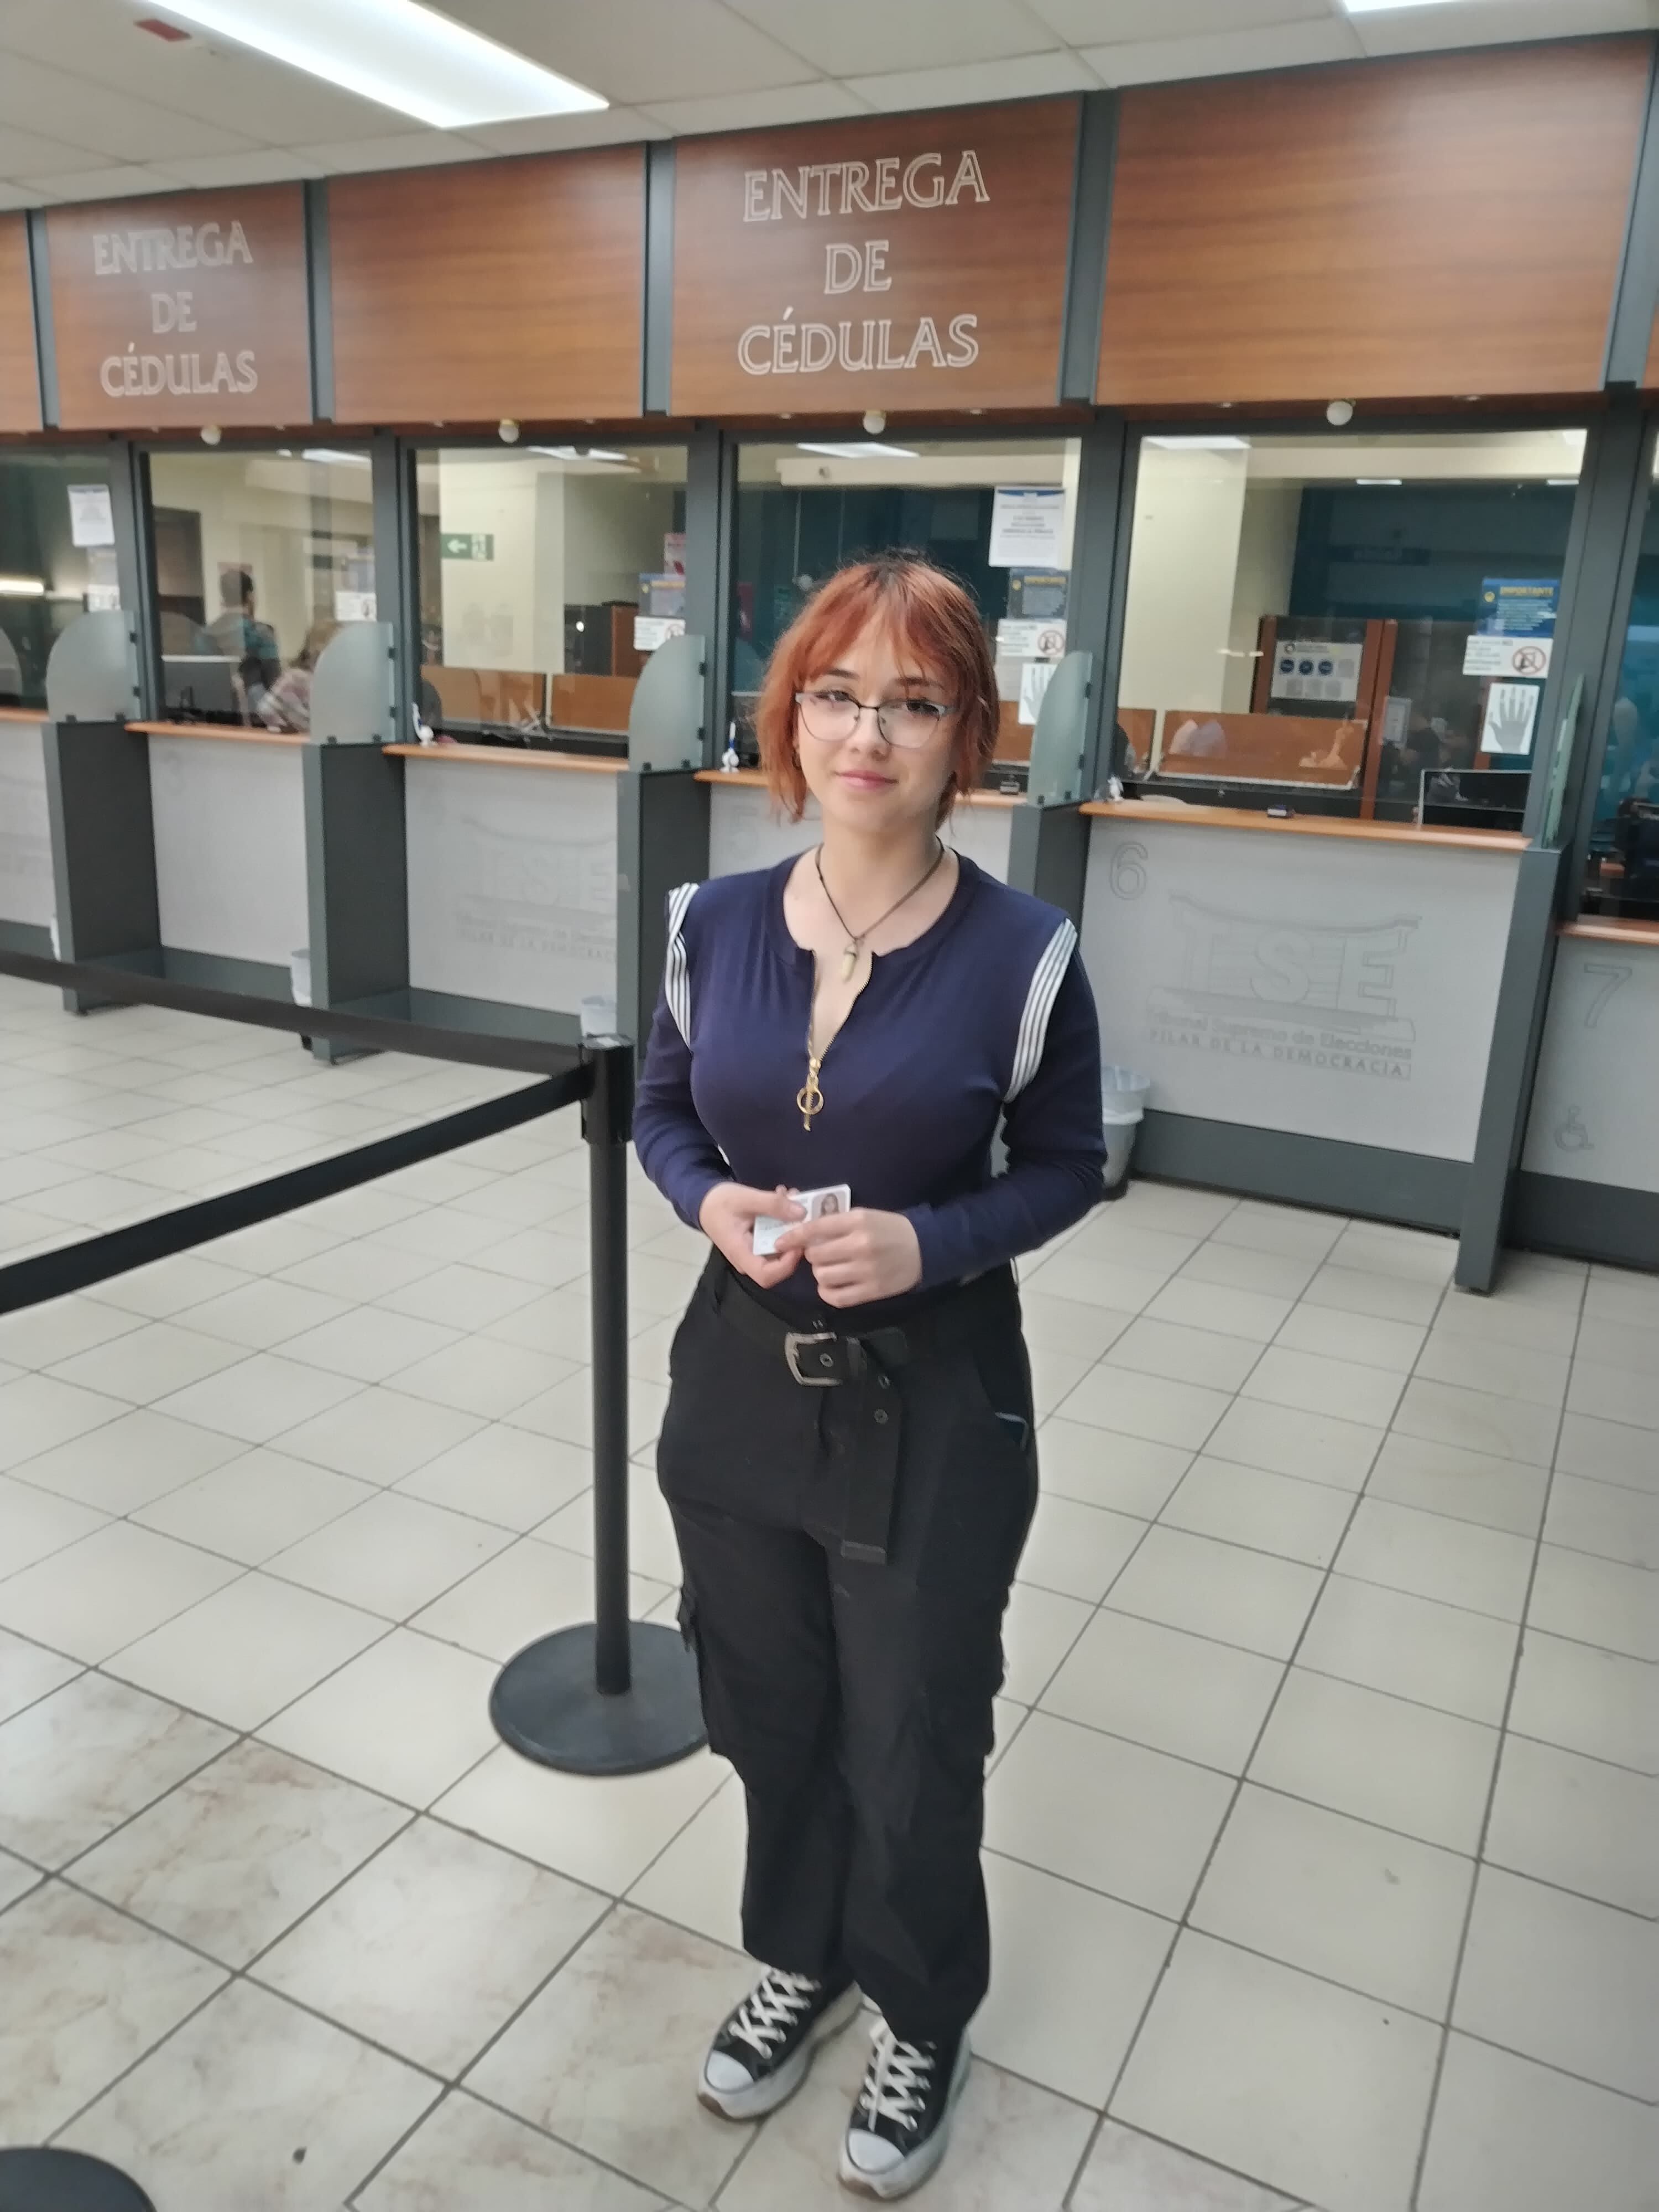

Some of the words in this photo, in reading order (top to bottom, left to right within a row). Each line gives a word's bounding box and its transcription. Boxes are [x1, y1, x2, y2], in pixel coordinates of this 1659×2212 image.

[743, 150, 990, 222] ENTREGA
[92, 220, 254, 275] ENTREGA
[824, 240, 892, 294] DE
[151, 291, 197, 333] DE
[737, 306, 979, 375] CÉDULAS
[100, 342, 258, 398] CÉDULAS
[1109, 841, 1148, 900] 6
[1583, 962, 1633, 1029] 7
[1240, 1041, 1263, 1057] LA
[1273, 1044, 1403, 1077] DEMOCRACIA
